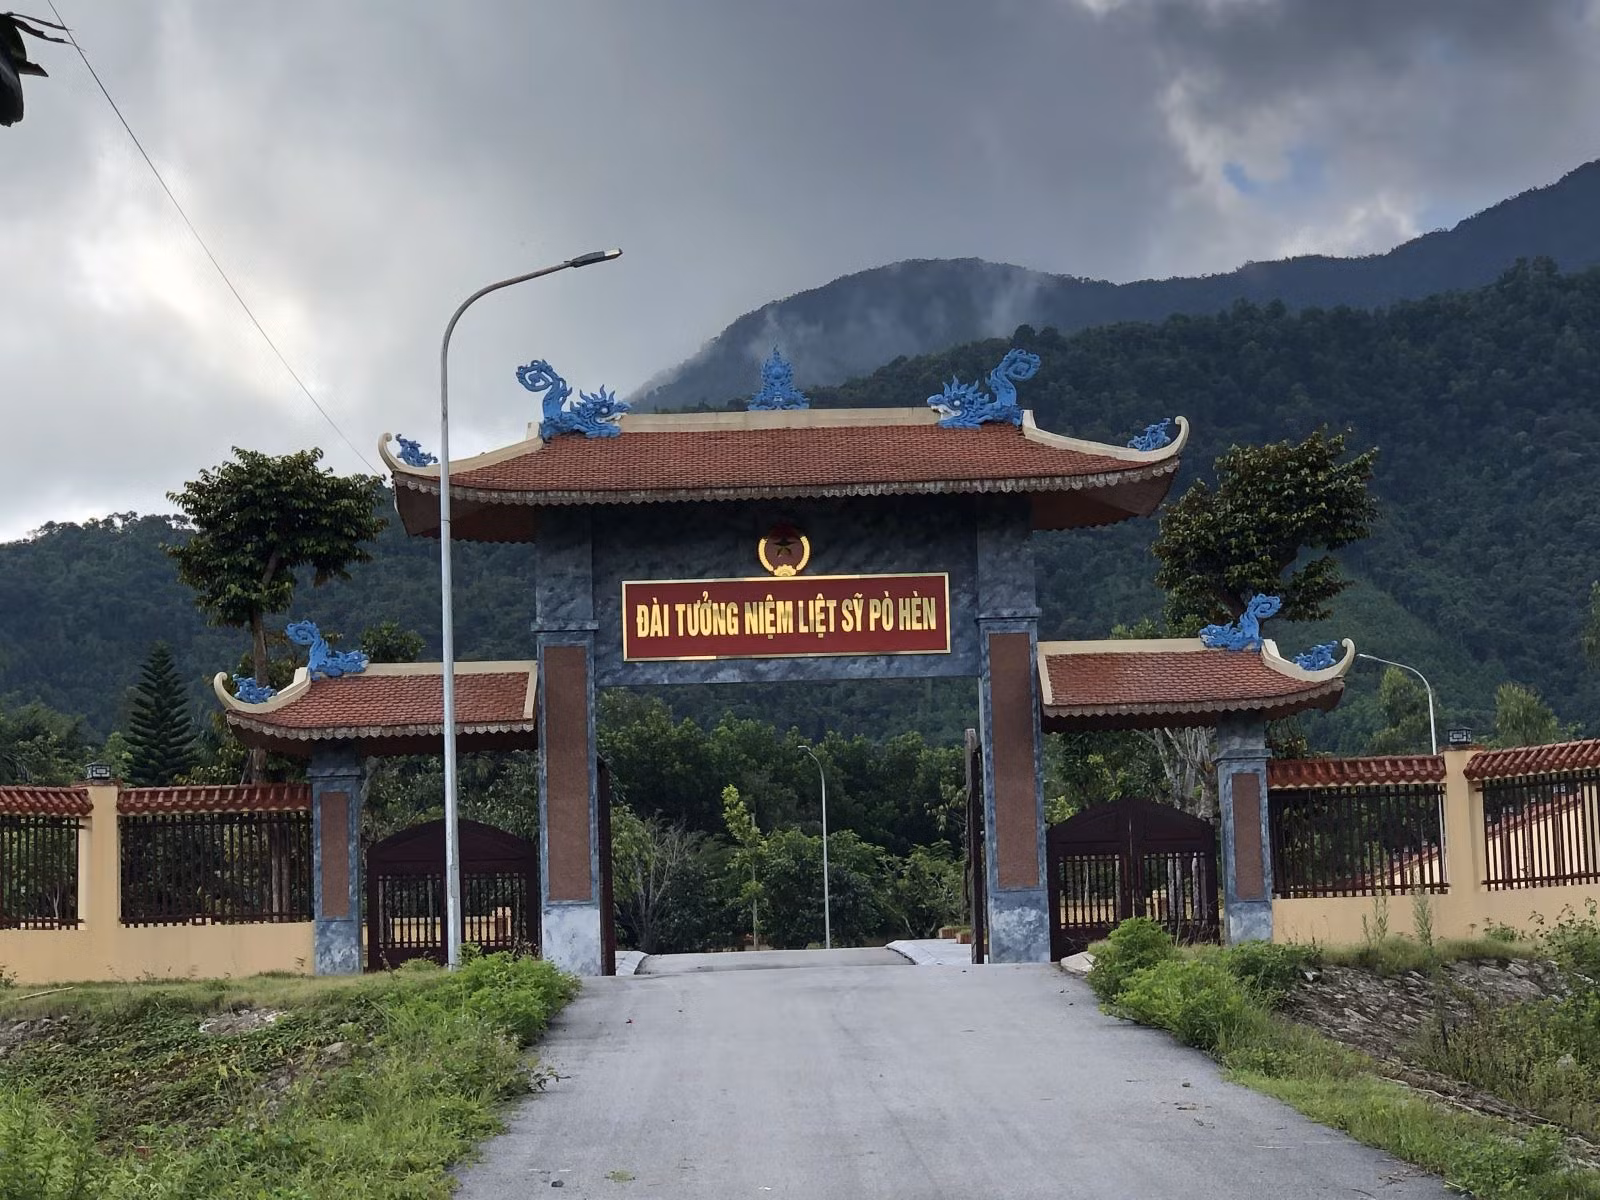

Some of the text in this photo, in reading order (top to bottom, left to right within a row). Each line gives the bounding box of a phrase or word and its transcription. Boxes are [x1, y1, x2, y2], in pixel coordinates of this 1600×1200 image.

[636, 591, 937, 640] ĐÀI TƯỞNG NIỆM LIỆT SỸ PÒ HÈN
